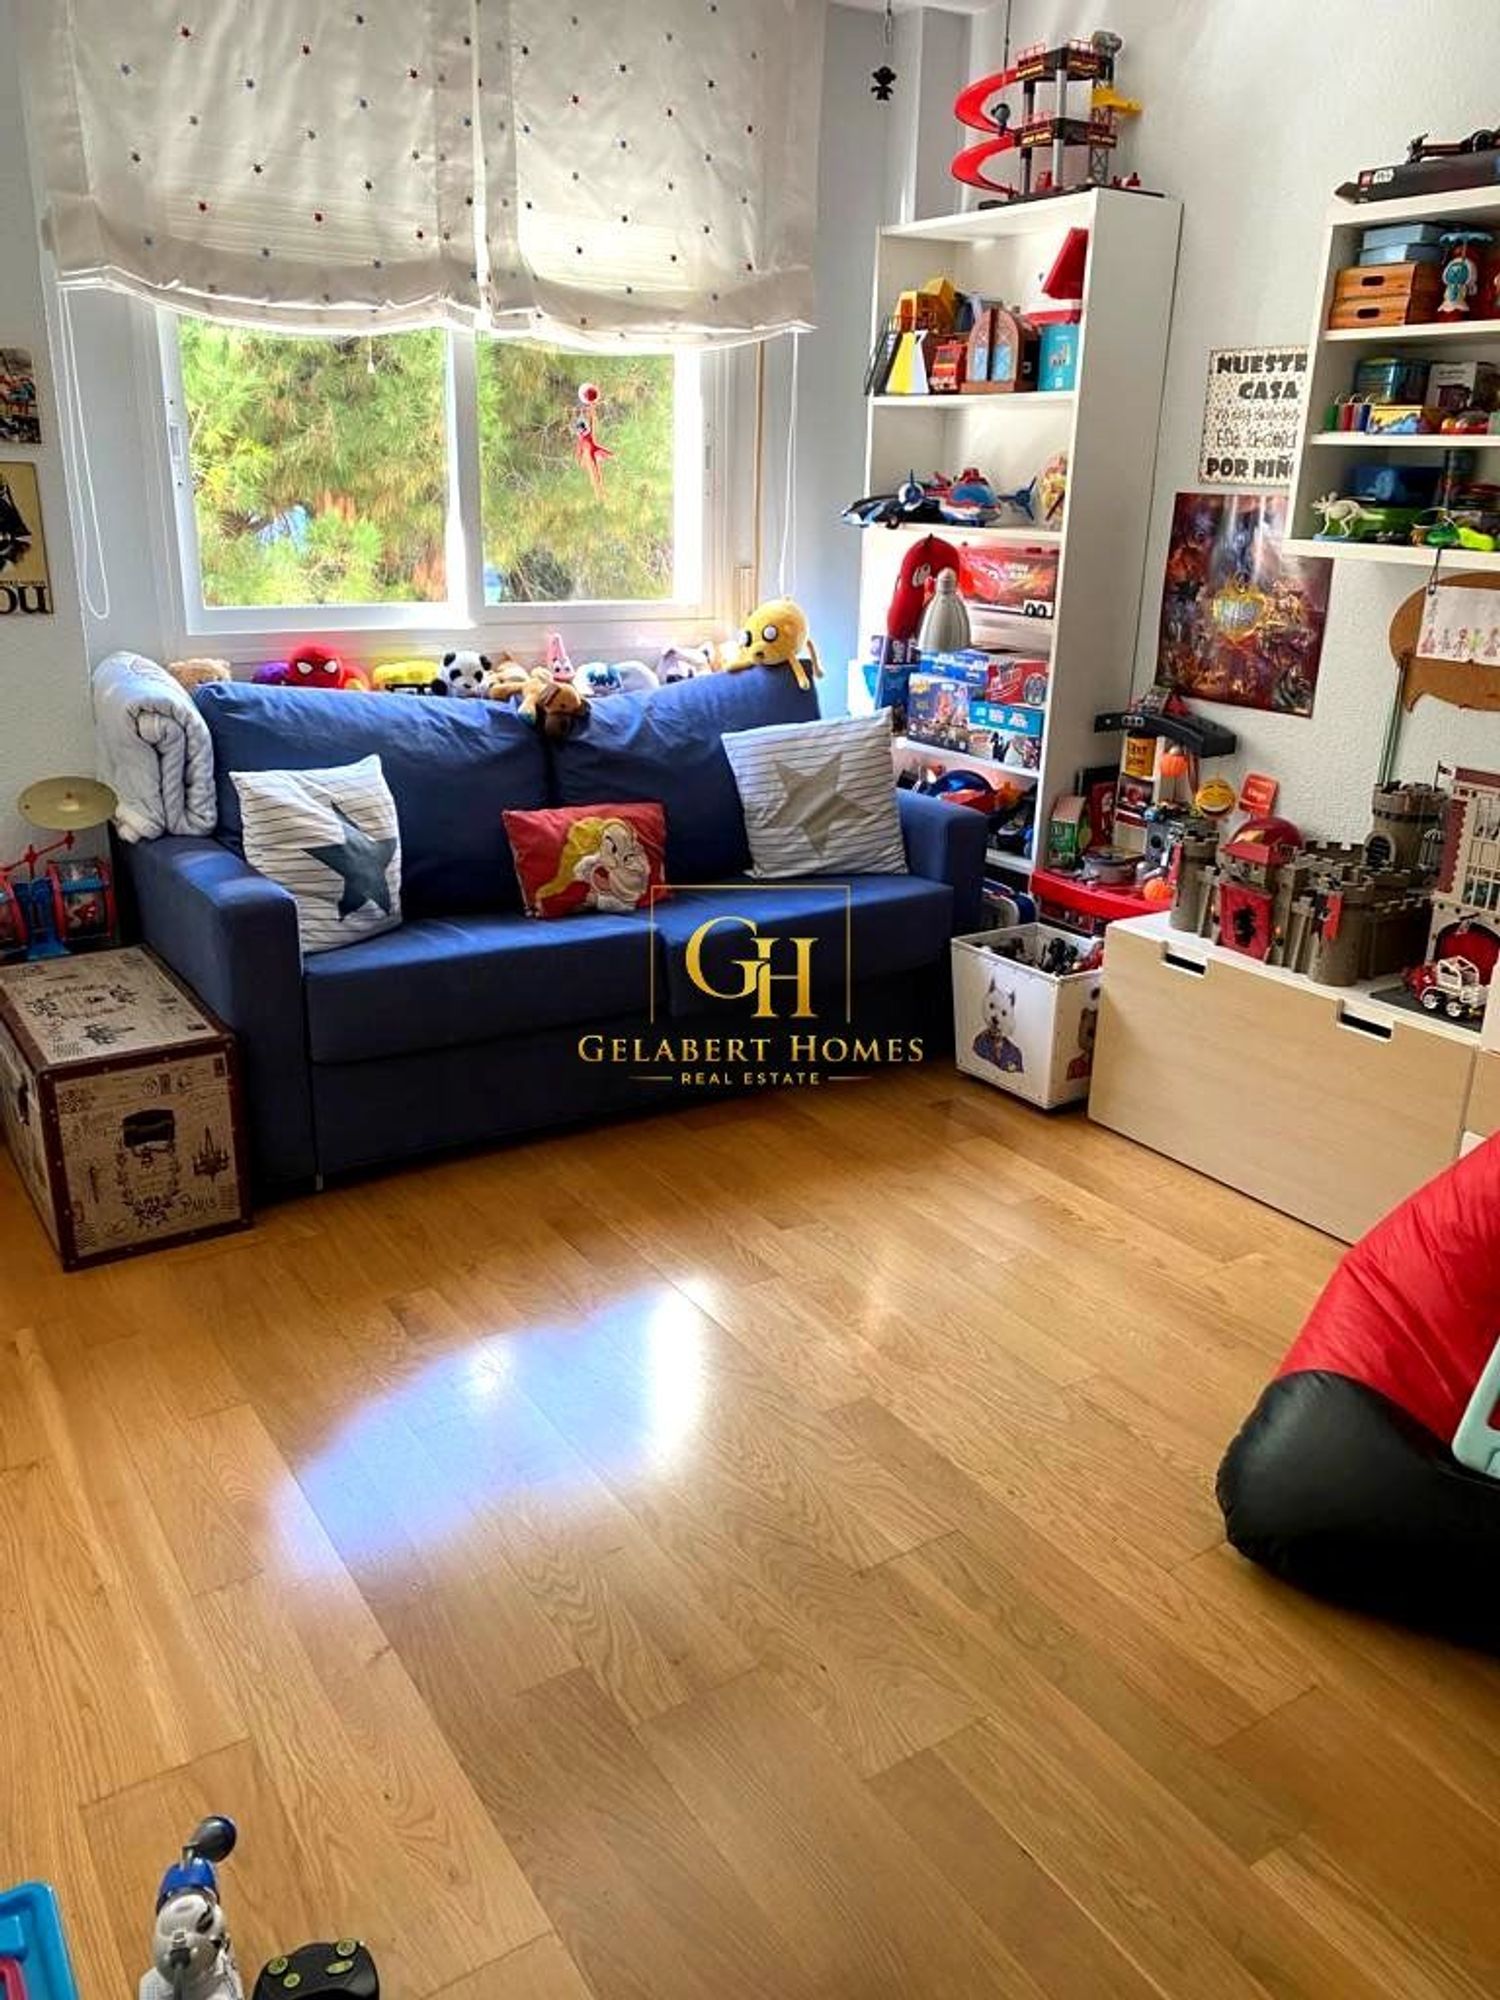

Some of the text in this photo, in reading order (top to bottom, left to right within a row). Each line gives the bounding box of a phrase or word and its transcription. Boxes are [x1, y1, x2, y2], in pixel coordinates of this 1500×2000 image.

[1239, 381, 1298, 399] CASA
[1206, 453, 1294, 478] POR NIÑ
